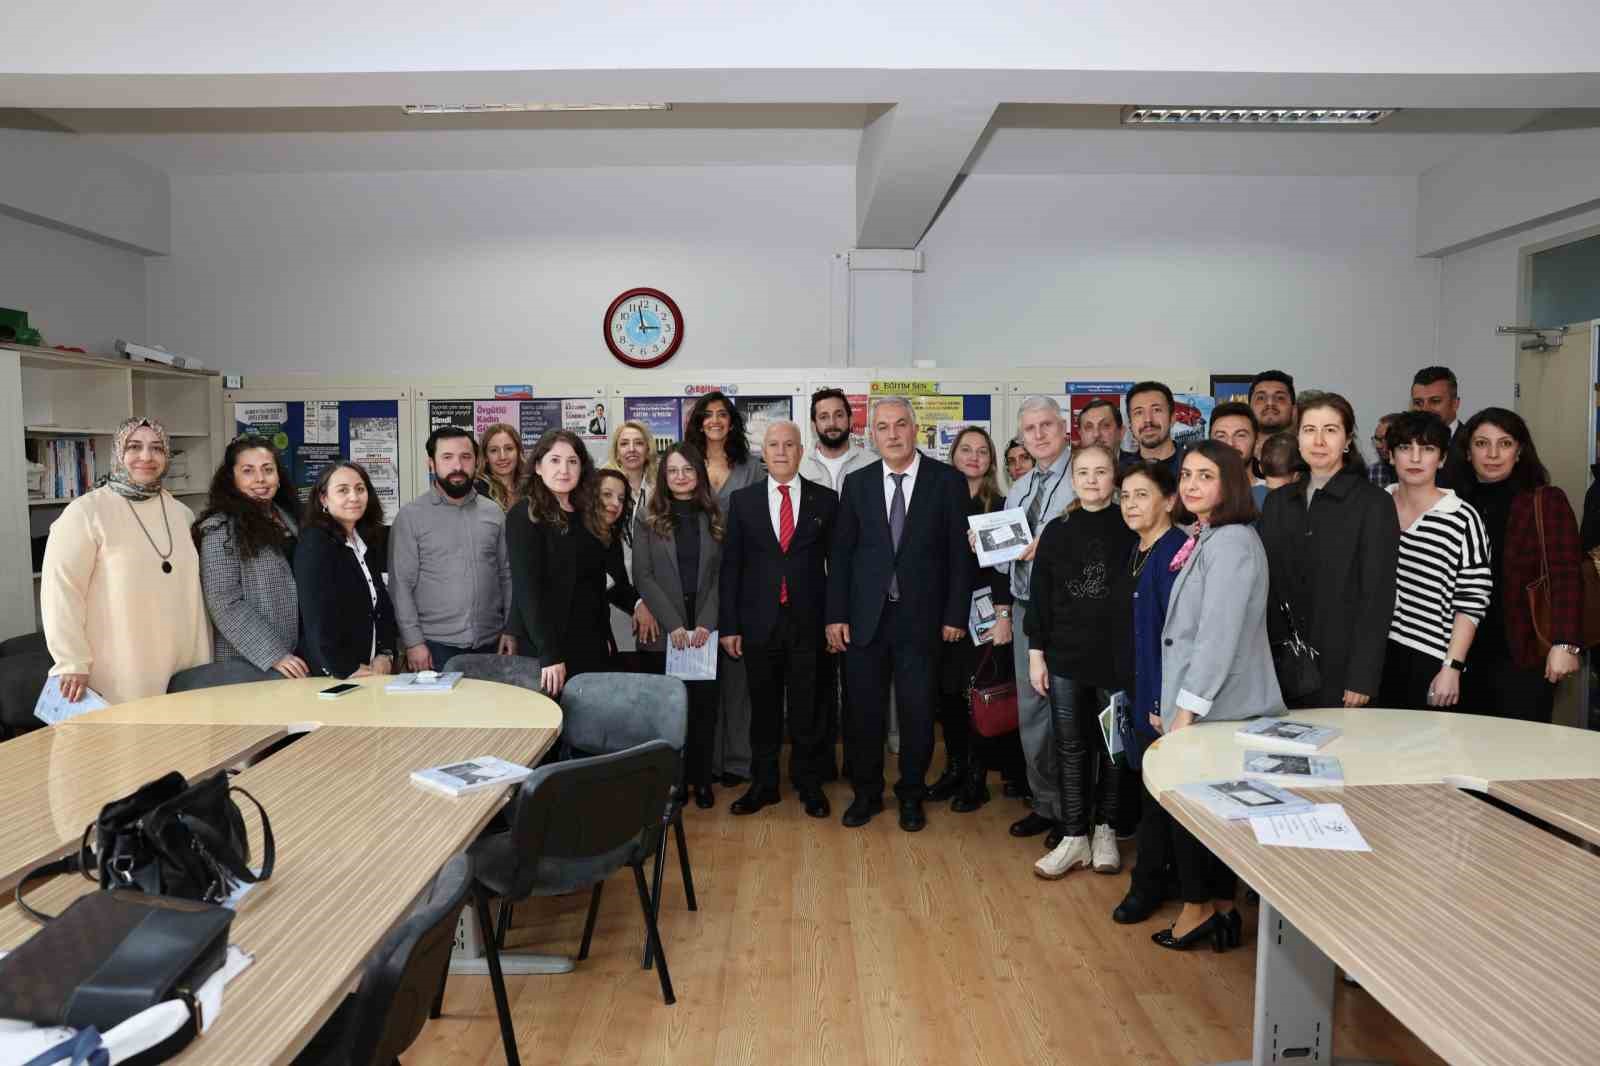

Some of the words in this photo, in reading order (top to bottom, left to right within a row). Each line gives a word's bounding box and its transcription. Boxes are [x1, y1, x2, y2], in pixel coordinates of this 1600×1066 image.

[629, 303, 636, 313] 11
[640, 299, 649, 309] 12
[655, 303, 659, 313] 1
[620, 312, 630, 320] 10
[661, 312, 668, 321] 2
[615, 323, 623, 332] 9
[664, 323, 671, 333] 3
[619, 335, 626, 344] 8
[660, 336, 666, 344] 4
[629, 344, 635, 353] 7
[640, 347, 647, 355] 6
[652, 344, 660, 353] 5
[476, 416, 500, 424] Kadın
